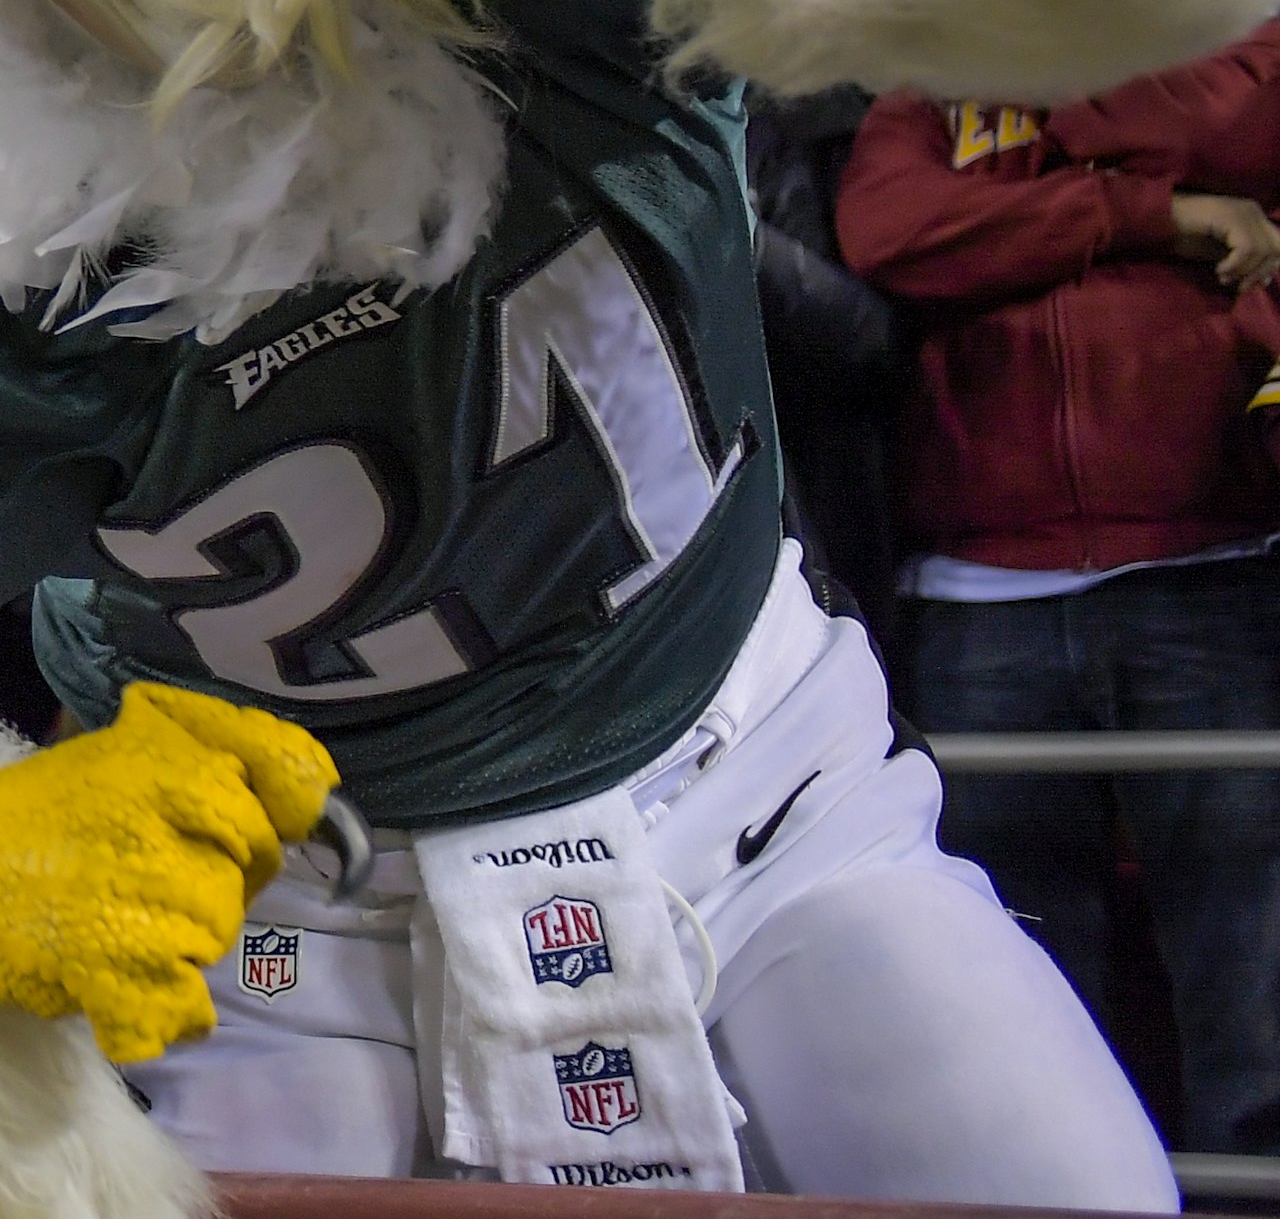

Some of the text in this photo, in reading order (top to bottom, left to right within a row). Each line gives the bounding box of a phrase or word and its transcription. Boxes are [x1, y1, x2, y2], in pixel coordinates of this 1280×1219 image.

[215, 283, 402, 410] EAGLES
[97, 226, 743, 702] 21
[486, 838, 616, 868] Wilson
[529, 904, 600, 950] NFL
[248, 957, 292, 989] NFL
[566, 1081, 636, 1126] NFL
[546, 1162, 674, 1187] Wilson
